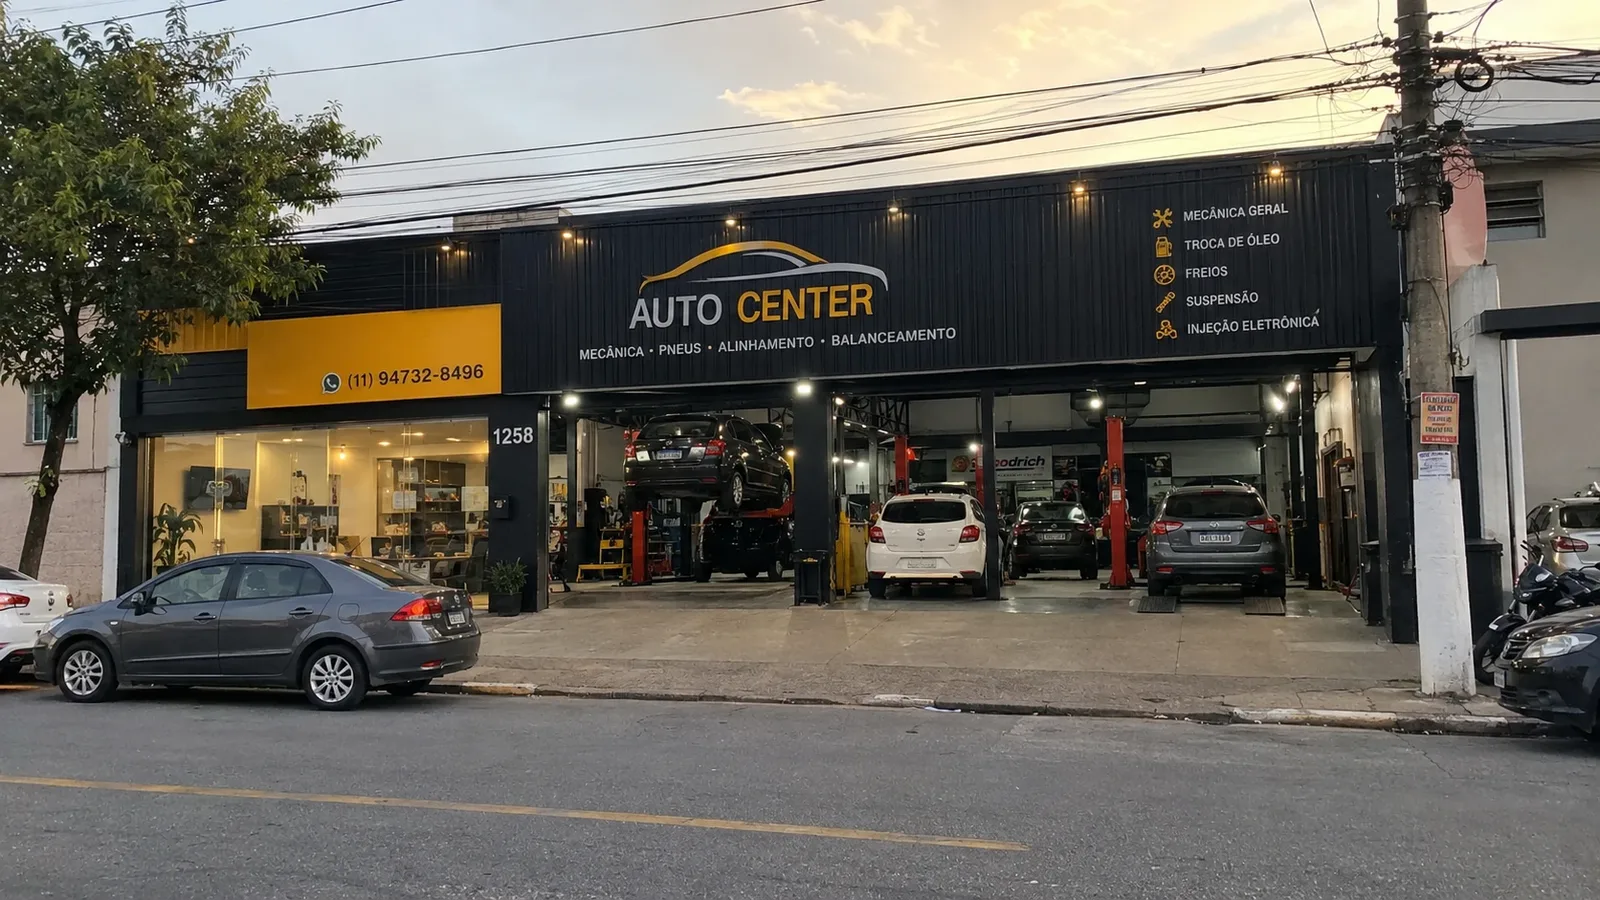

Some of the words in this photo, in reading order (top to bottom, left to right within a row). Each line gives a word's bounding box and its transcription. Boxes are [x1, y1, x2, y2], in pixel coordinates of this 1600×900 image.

[1183, 206, 1246, 222] MECÂNICA
[1248, 203, 1289, 217] GERAL
[1184, 237, 1225, 251] TROCA
[1228, 236, 1244, 248] DE
[1246, 232, 1280, 246] ÓLEO
[1185, 266, 1228, 279] FREIOS
[628, 292, 722, 329] AUTO
[736, 282, 873, 323] CENTER
[1186, 290, 1259, 307] SUSPENSÃO
[1187, 319, 1239, 336] INJEÇÃO
[579, 344, 645, 361] MECÂNICA
[658, 342, 702, 356] PNEUS
[718, 336, 814, 353] ALINHAMENTO
[831, 327, 957, 347] BALANCEAMENTO
[347, 373, 373, 390] (11)
[378, 364, 484, 386] 94732-8496
[493, 426, 534, 445] 1258
